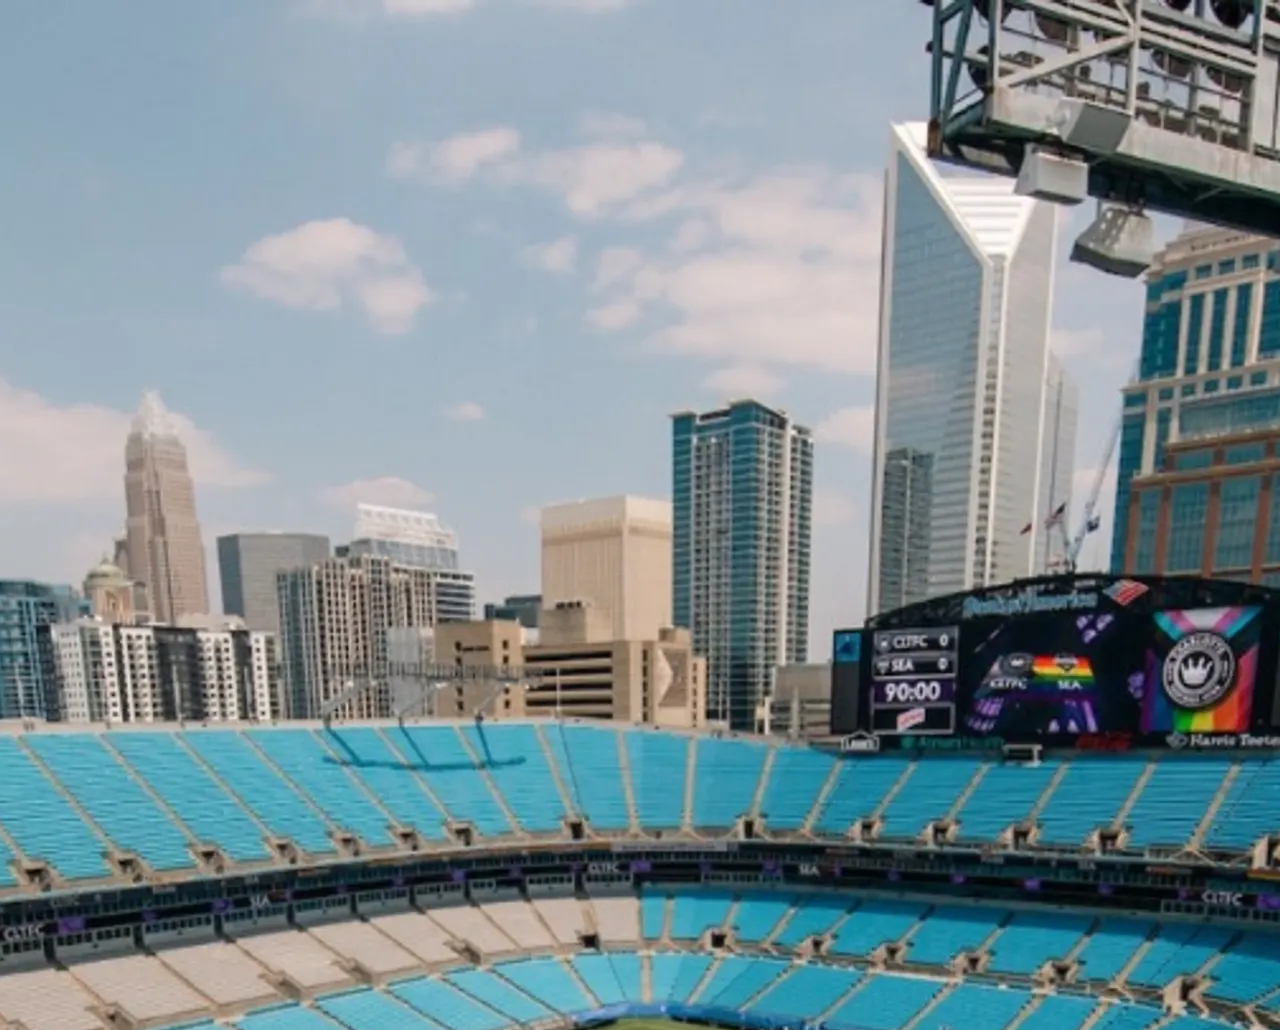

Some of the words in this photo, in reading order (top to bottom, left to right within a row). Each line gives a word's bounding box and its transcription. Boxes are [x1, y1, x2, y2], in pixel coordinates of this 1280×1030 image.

[939, 634, 949, 647] 0
[891, 658, 914, 672] SEA
[884, 681, 941, 702] 90:00
[1190, 733, 1236, 748] Harris
